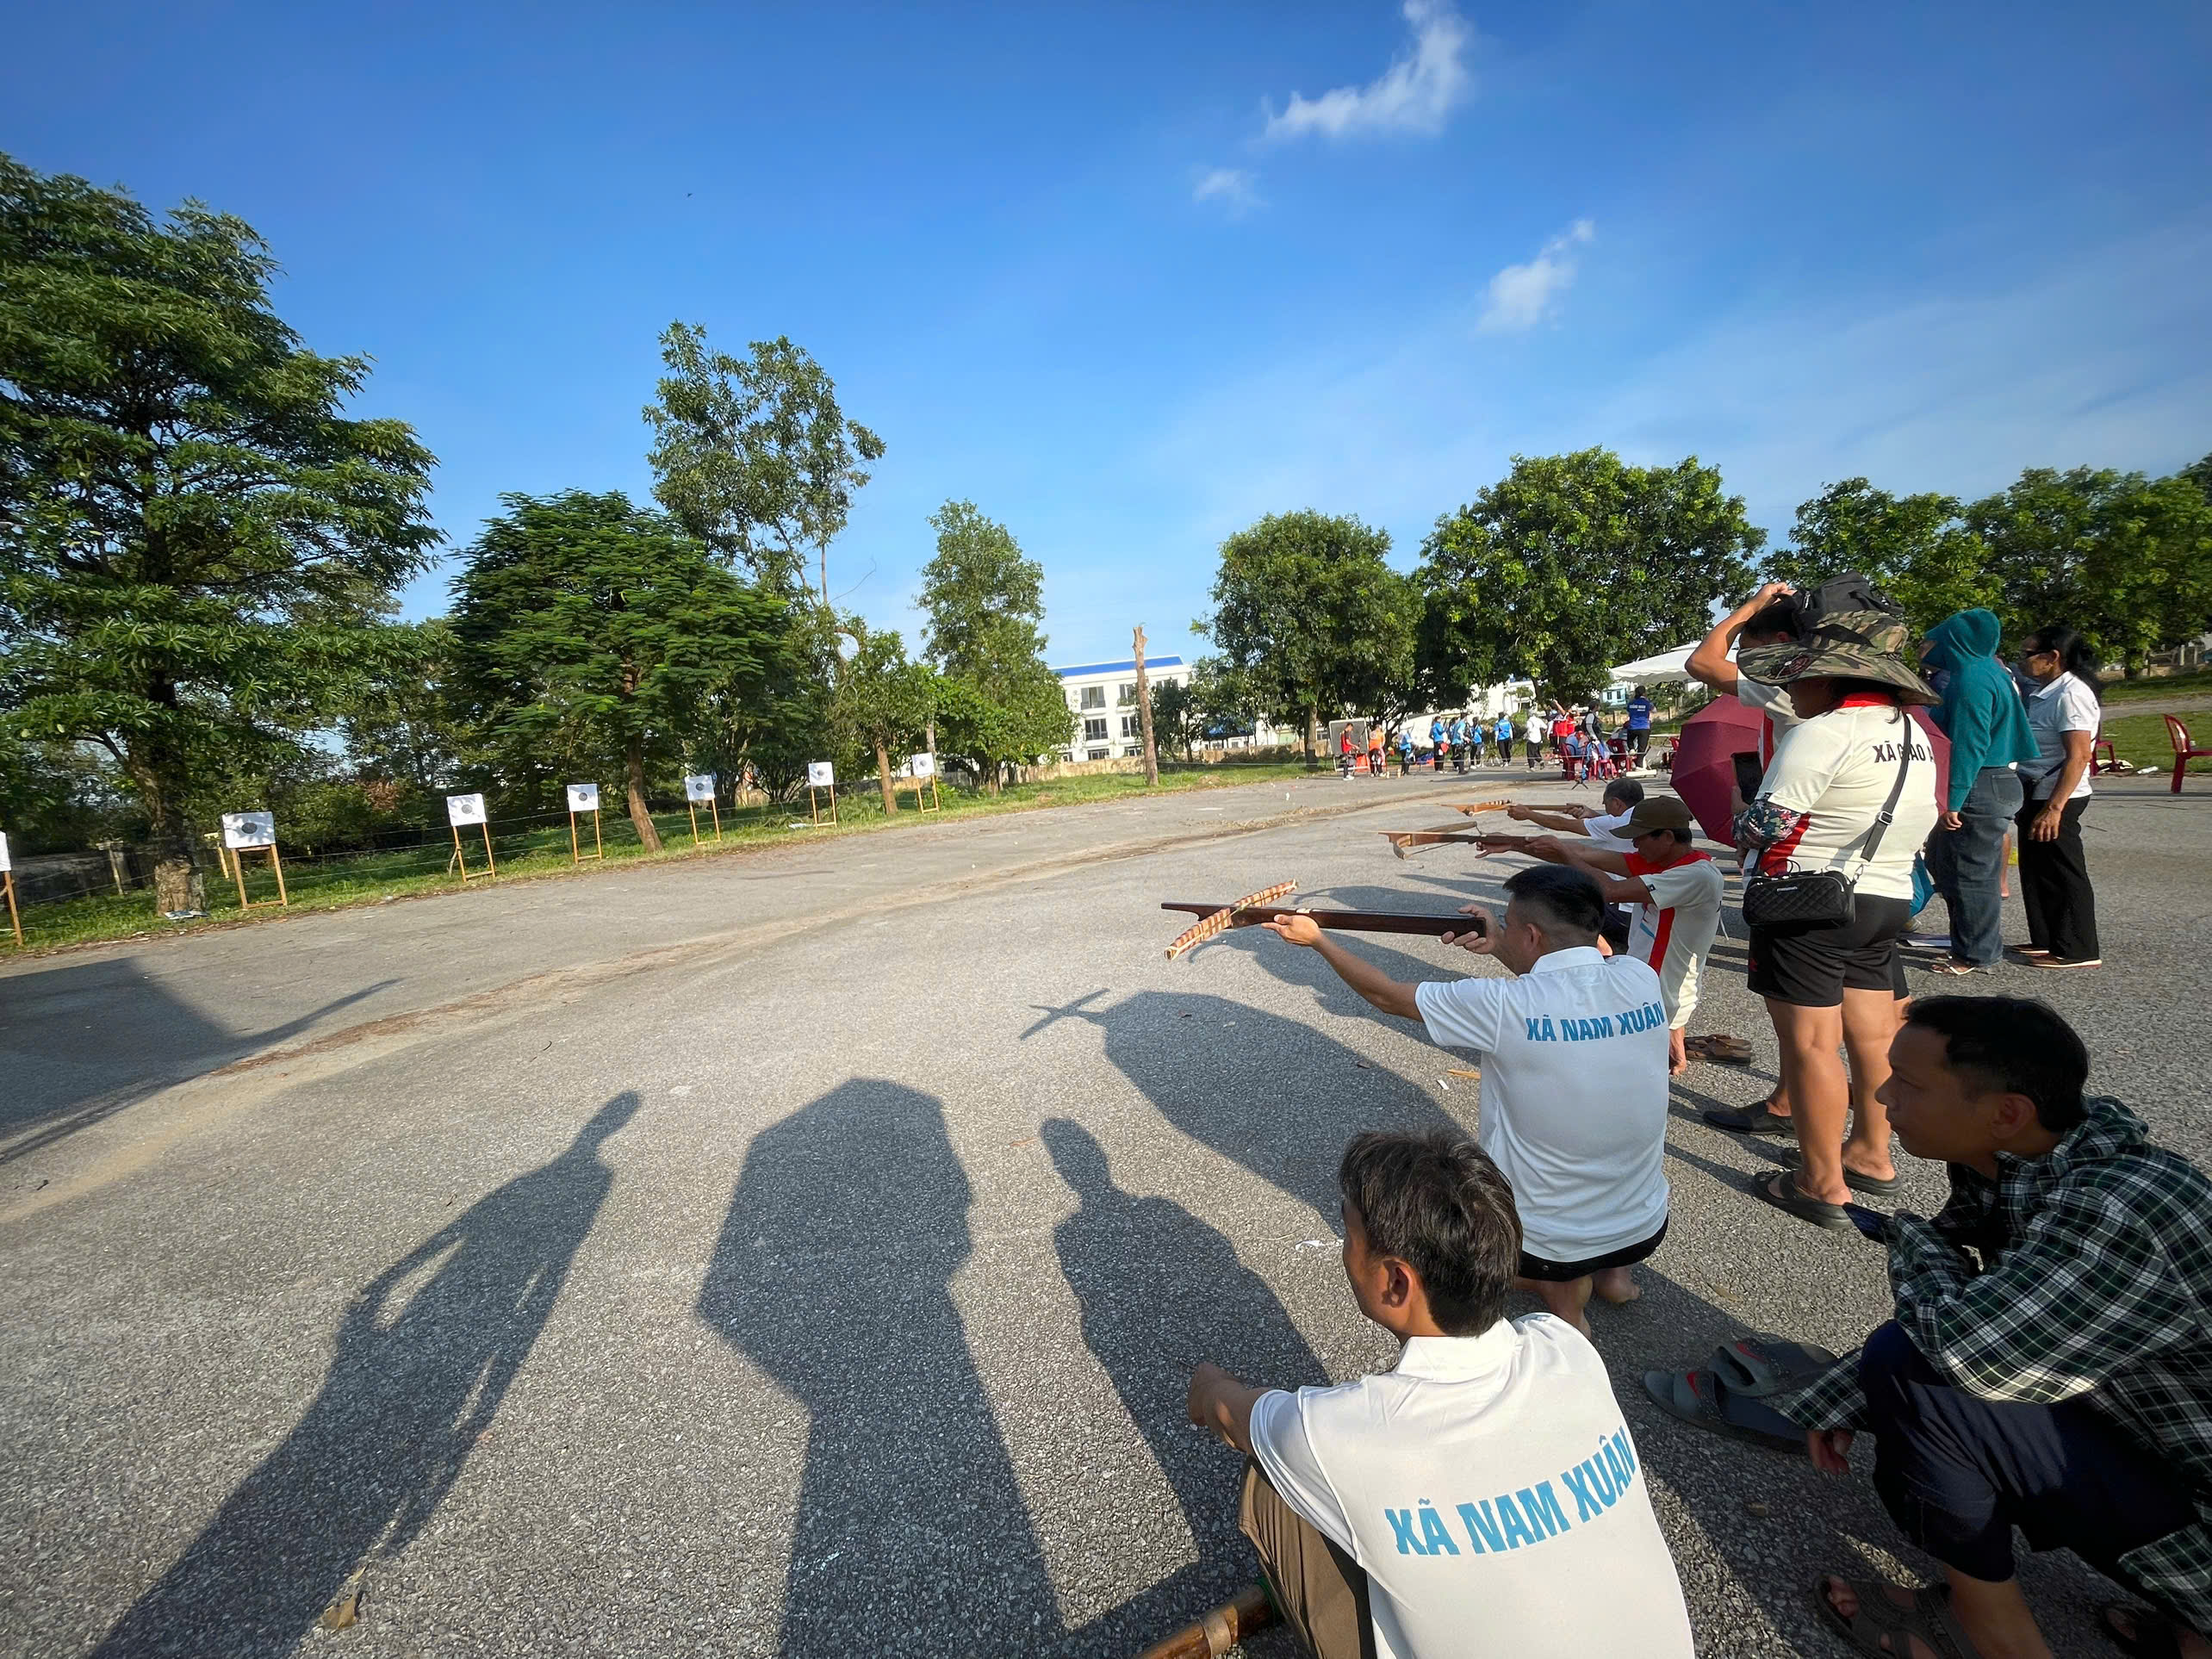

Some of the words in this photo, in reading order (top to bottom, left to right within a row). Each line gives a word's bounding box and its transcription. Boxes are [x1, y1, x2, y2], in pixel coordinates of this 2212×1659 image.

[1872, 740, 1896, 763] XÃ
[1897, 743, 1926, 761] GAO
[1525, 1014, 1557, 1041] XÃ
[1560, 1016, 1614, 1041] NAM
[1615, 1001, 1665, 1035] XUÂN
[1384, 1498, 1461, 1556] XÃ
[1456, 1480, 1571, 1555] NAM
[1560, 1425, 1636, 1524] XUÂN
